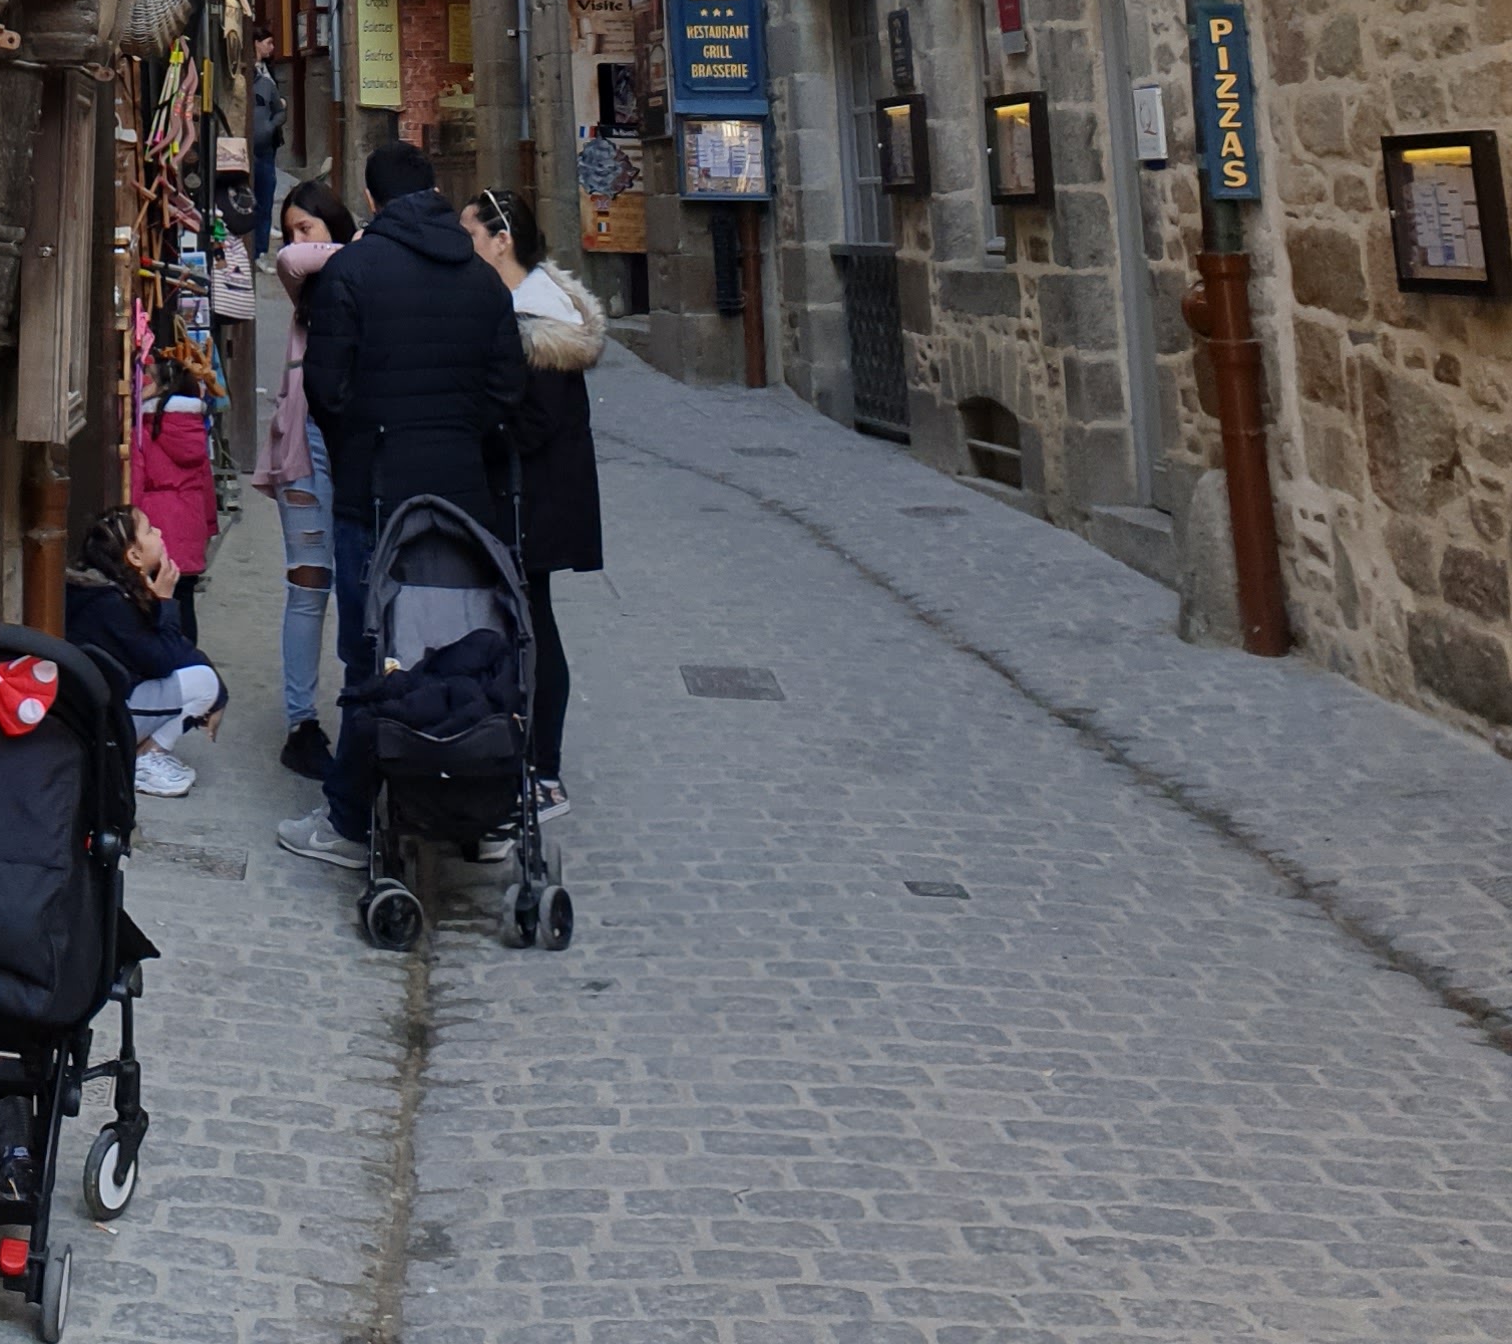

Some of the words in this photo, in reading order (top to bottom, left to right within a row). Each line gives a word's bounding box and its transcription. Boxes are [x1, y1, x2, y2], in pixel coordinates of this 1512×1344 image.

[687, 25, 750, 39] RESTAURANT
[703, 45, 733, 59] GRILL
[691, 64, 750, 79] BRASSERIE
[1209, 18, 1248, 187] PIZZAS
